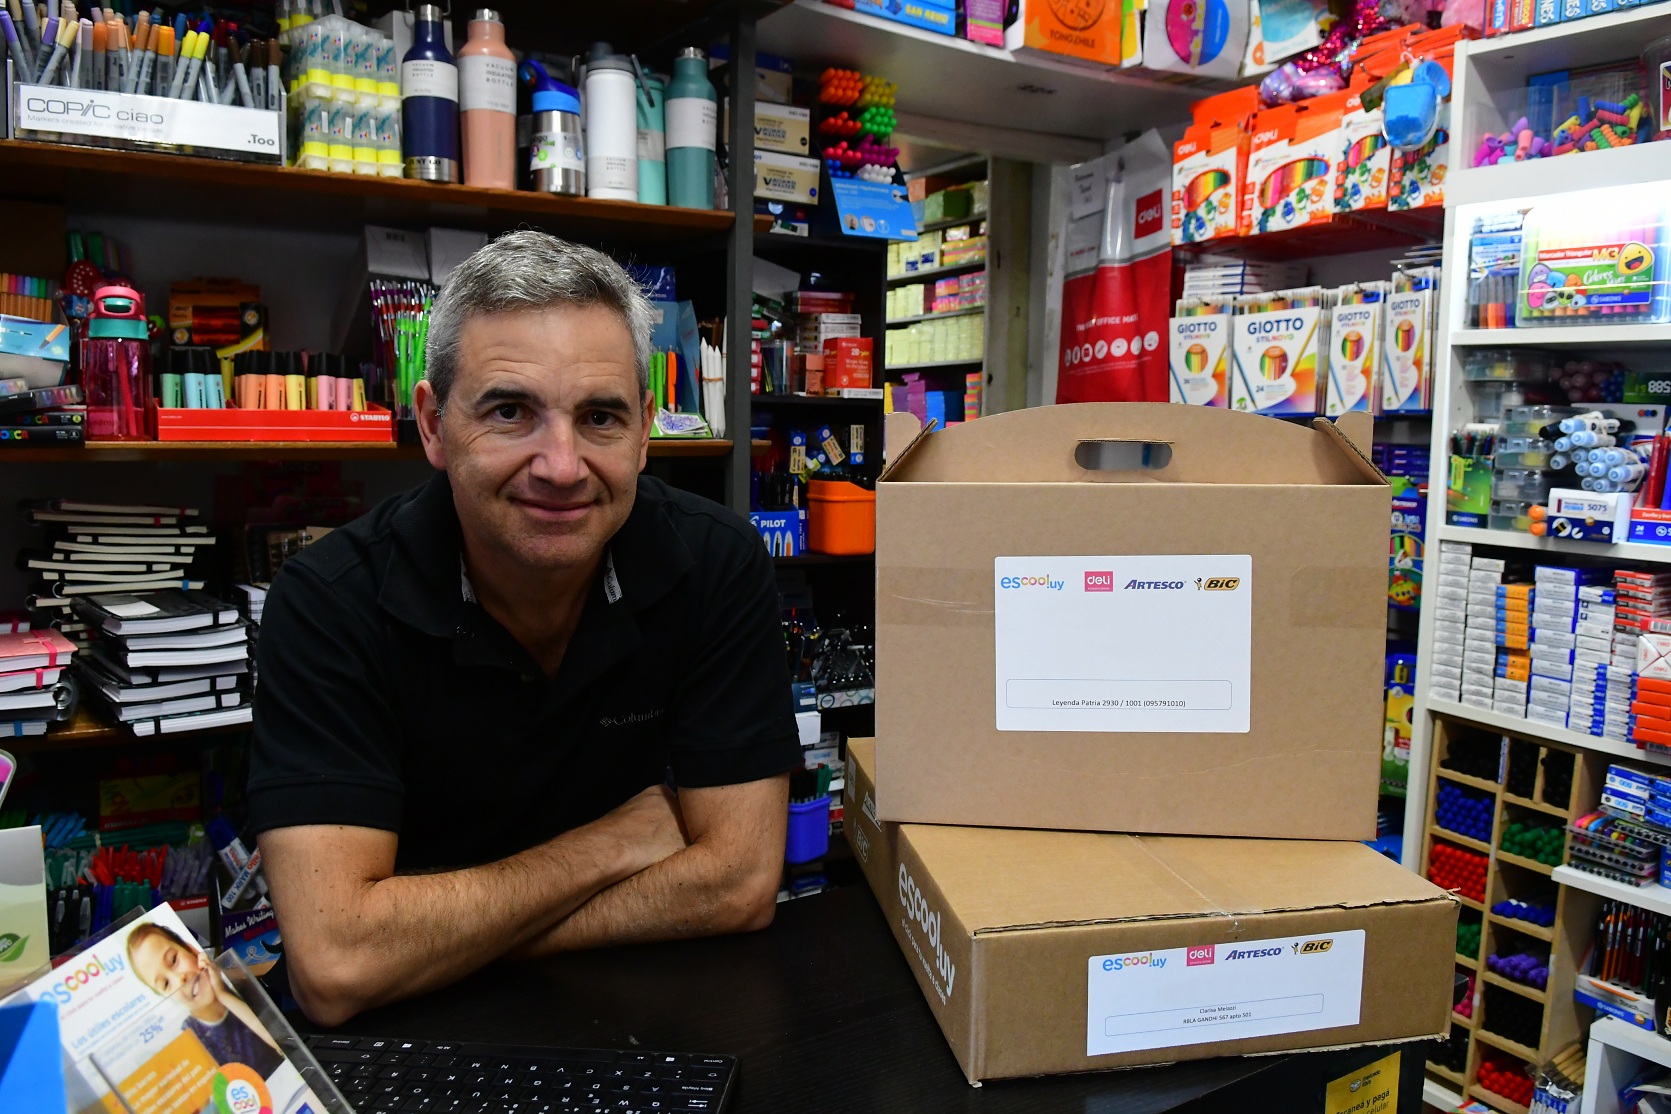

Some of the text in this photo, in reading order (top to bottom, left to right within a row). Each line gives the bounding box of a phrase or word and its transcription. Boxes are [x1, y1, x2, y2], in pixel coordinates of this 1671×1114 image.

[27, 97, 163, 124] COPIC ciao
[1391, 299, 1420, 310] GIOTTO
[1337, 311, 1371, 322] GIOTTO
[1177, 321, 1217, 334] GIOTTO
[1247, 317, 1303, 335] GIOTTO
[360, 413, 391, 421] STABILO
[1587, 503, 1607, 512] 5075
[761, 519, 787, 528] PILOT
[1086, 574, 1111, 586] deli
[1124, 579, 1185, 590] ARTESCO
[1189, 948, 1213, 961] deli
[1225, 946, 1283, 961] ARTESCO
[71, 993, 146, 1051] Los útiles escolares
[1197, 1014, 1217, 1023] GANDHI
[1230, 1012, 1242, 1020] apto
[139, 1023, 164, 1045] 25%
[230, 1085, 249, 1101] es
